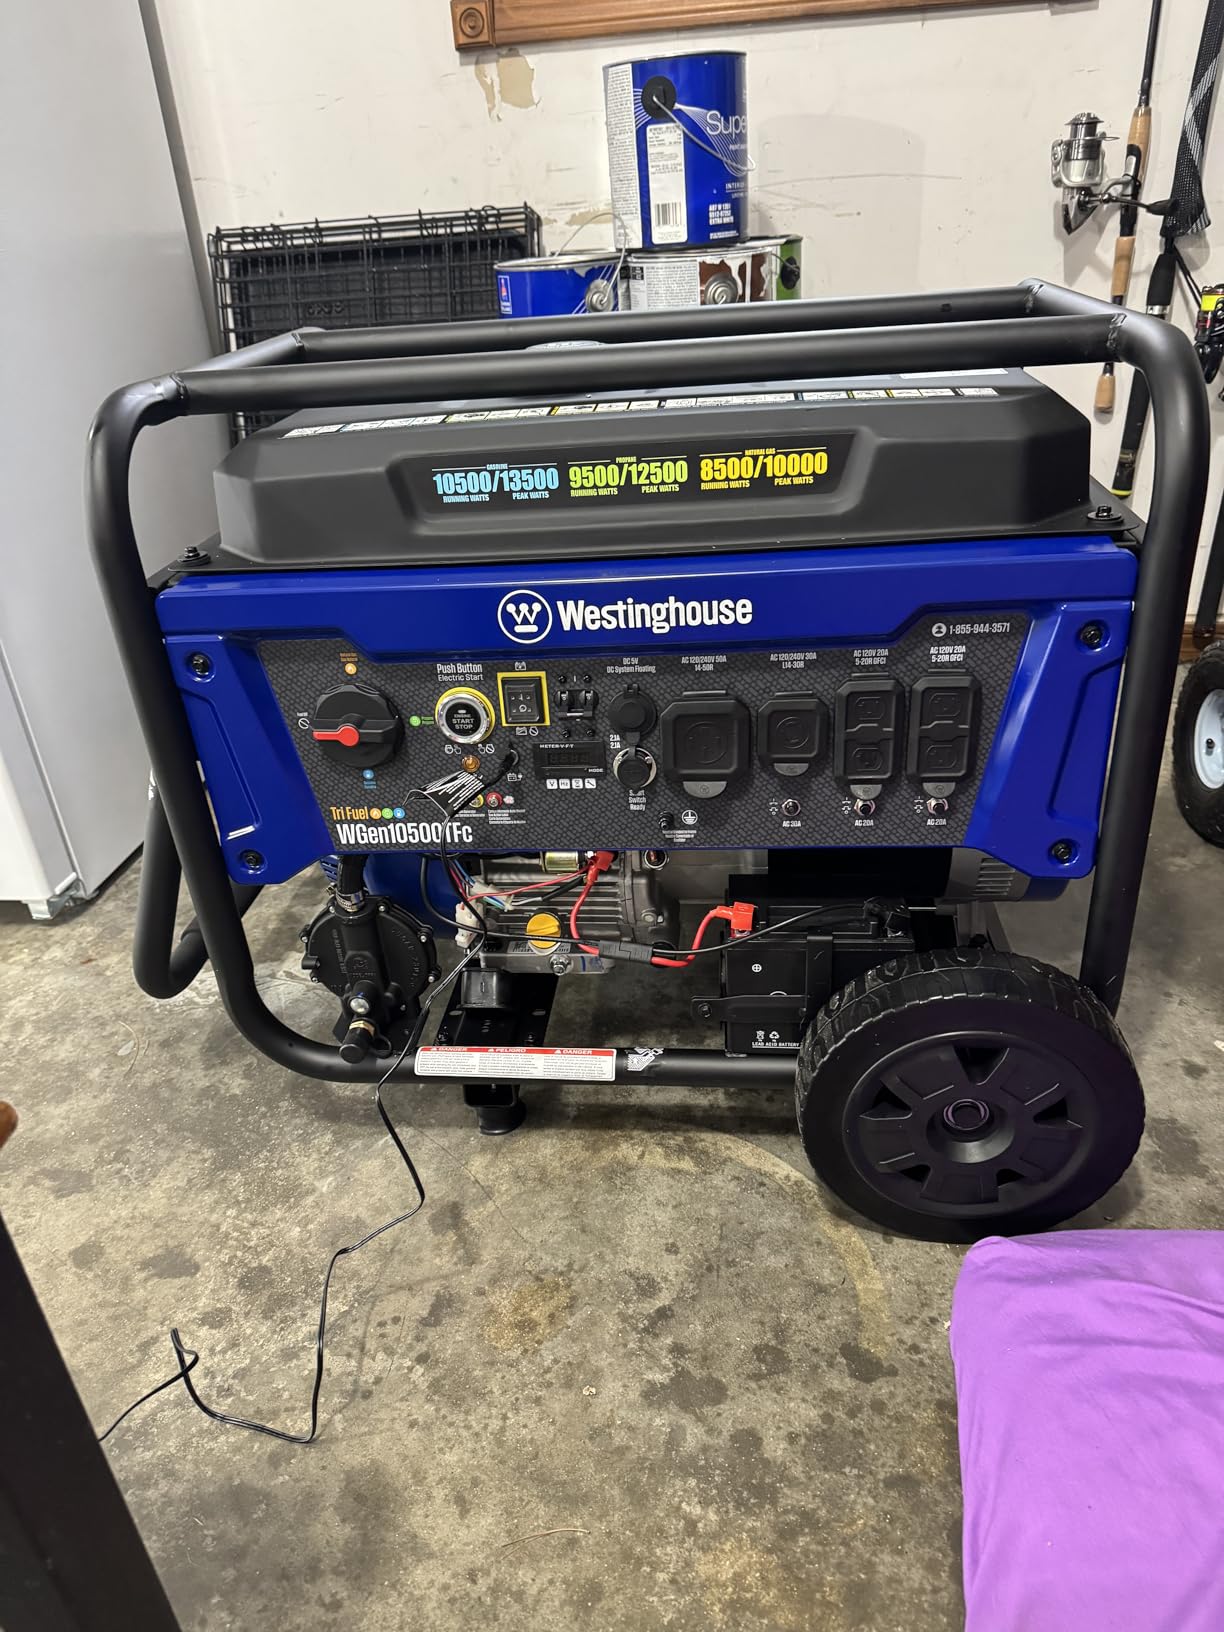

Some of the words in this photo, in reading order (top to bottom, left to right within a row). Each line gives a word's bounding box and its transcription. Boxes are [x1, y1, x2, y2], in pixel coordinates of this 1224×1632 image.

[700, 452, 828, 481] 8500/10000
[568, 460, 688, 488] 9500/12500
[432, 468, 560, 494] 10500/13500
[700, 482, 728, 490] RUNNING
[729, 480, 750, 488] WATTS
[774, 478, 792, 486] PEAK
[793, 476, 814, 484] WATTS
[570, 489, 598, 497] RUNNING
[598, 488, 618, 496] WATTS
[659, 484, 680, 492] WATTS
[443, 495, 470, 503] RUNNING
[470, 494, 490, 502] WATTS
[512, 492, 528, 500] PEAK
[529, 491, 550, 499] WATTS
[557, 596, 752, 634] Westinghouse
[949, 622, 1010, 634] 1-855-944-3571
[877, 648, 888, 656] 20A
[939, 646, 954, 654] 120V
[682, 656, 689, 664] AC
[779, 653, 805, 661] 120/240V
[805, 652, 817, 660] 30A
[932, 654, 948, 662] 5-20R
[949, 654, 964, 662] GFCI
[436, 664, 456, 674] Push
[457, 663, 482, 673] Button
[615, 666, 634, 674] System
[635, 665, 656, 673] Floating
[438, 674, 464, 682] Electric
[465, 673, 484, 681] Start
[628, 796, 646, 804] Switch
[630, 804, 646, 812] Ready
[330, 806, 345, 820] Tri
[346, 806, 368, 820] Fuel
[782, 820, 790, 828] AC
[936, 818, 946, 826] 20A
